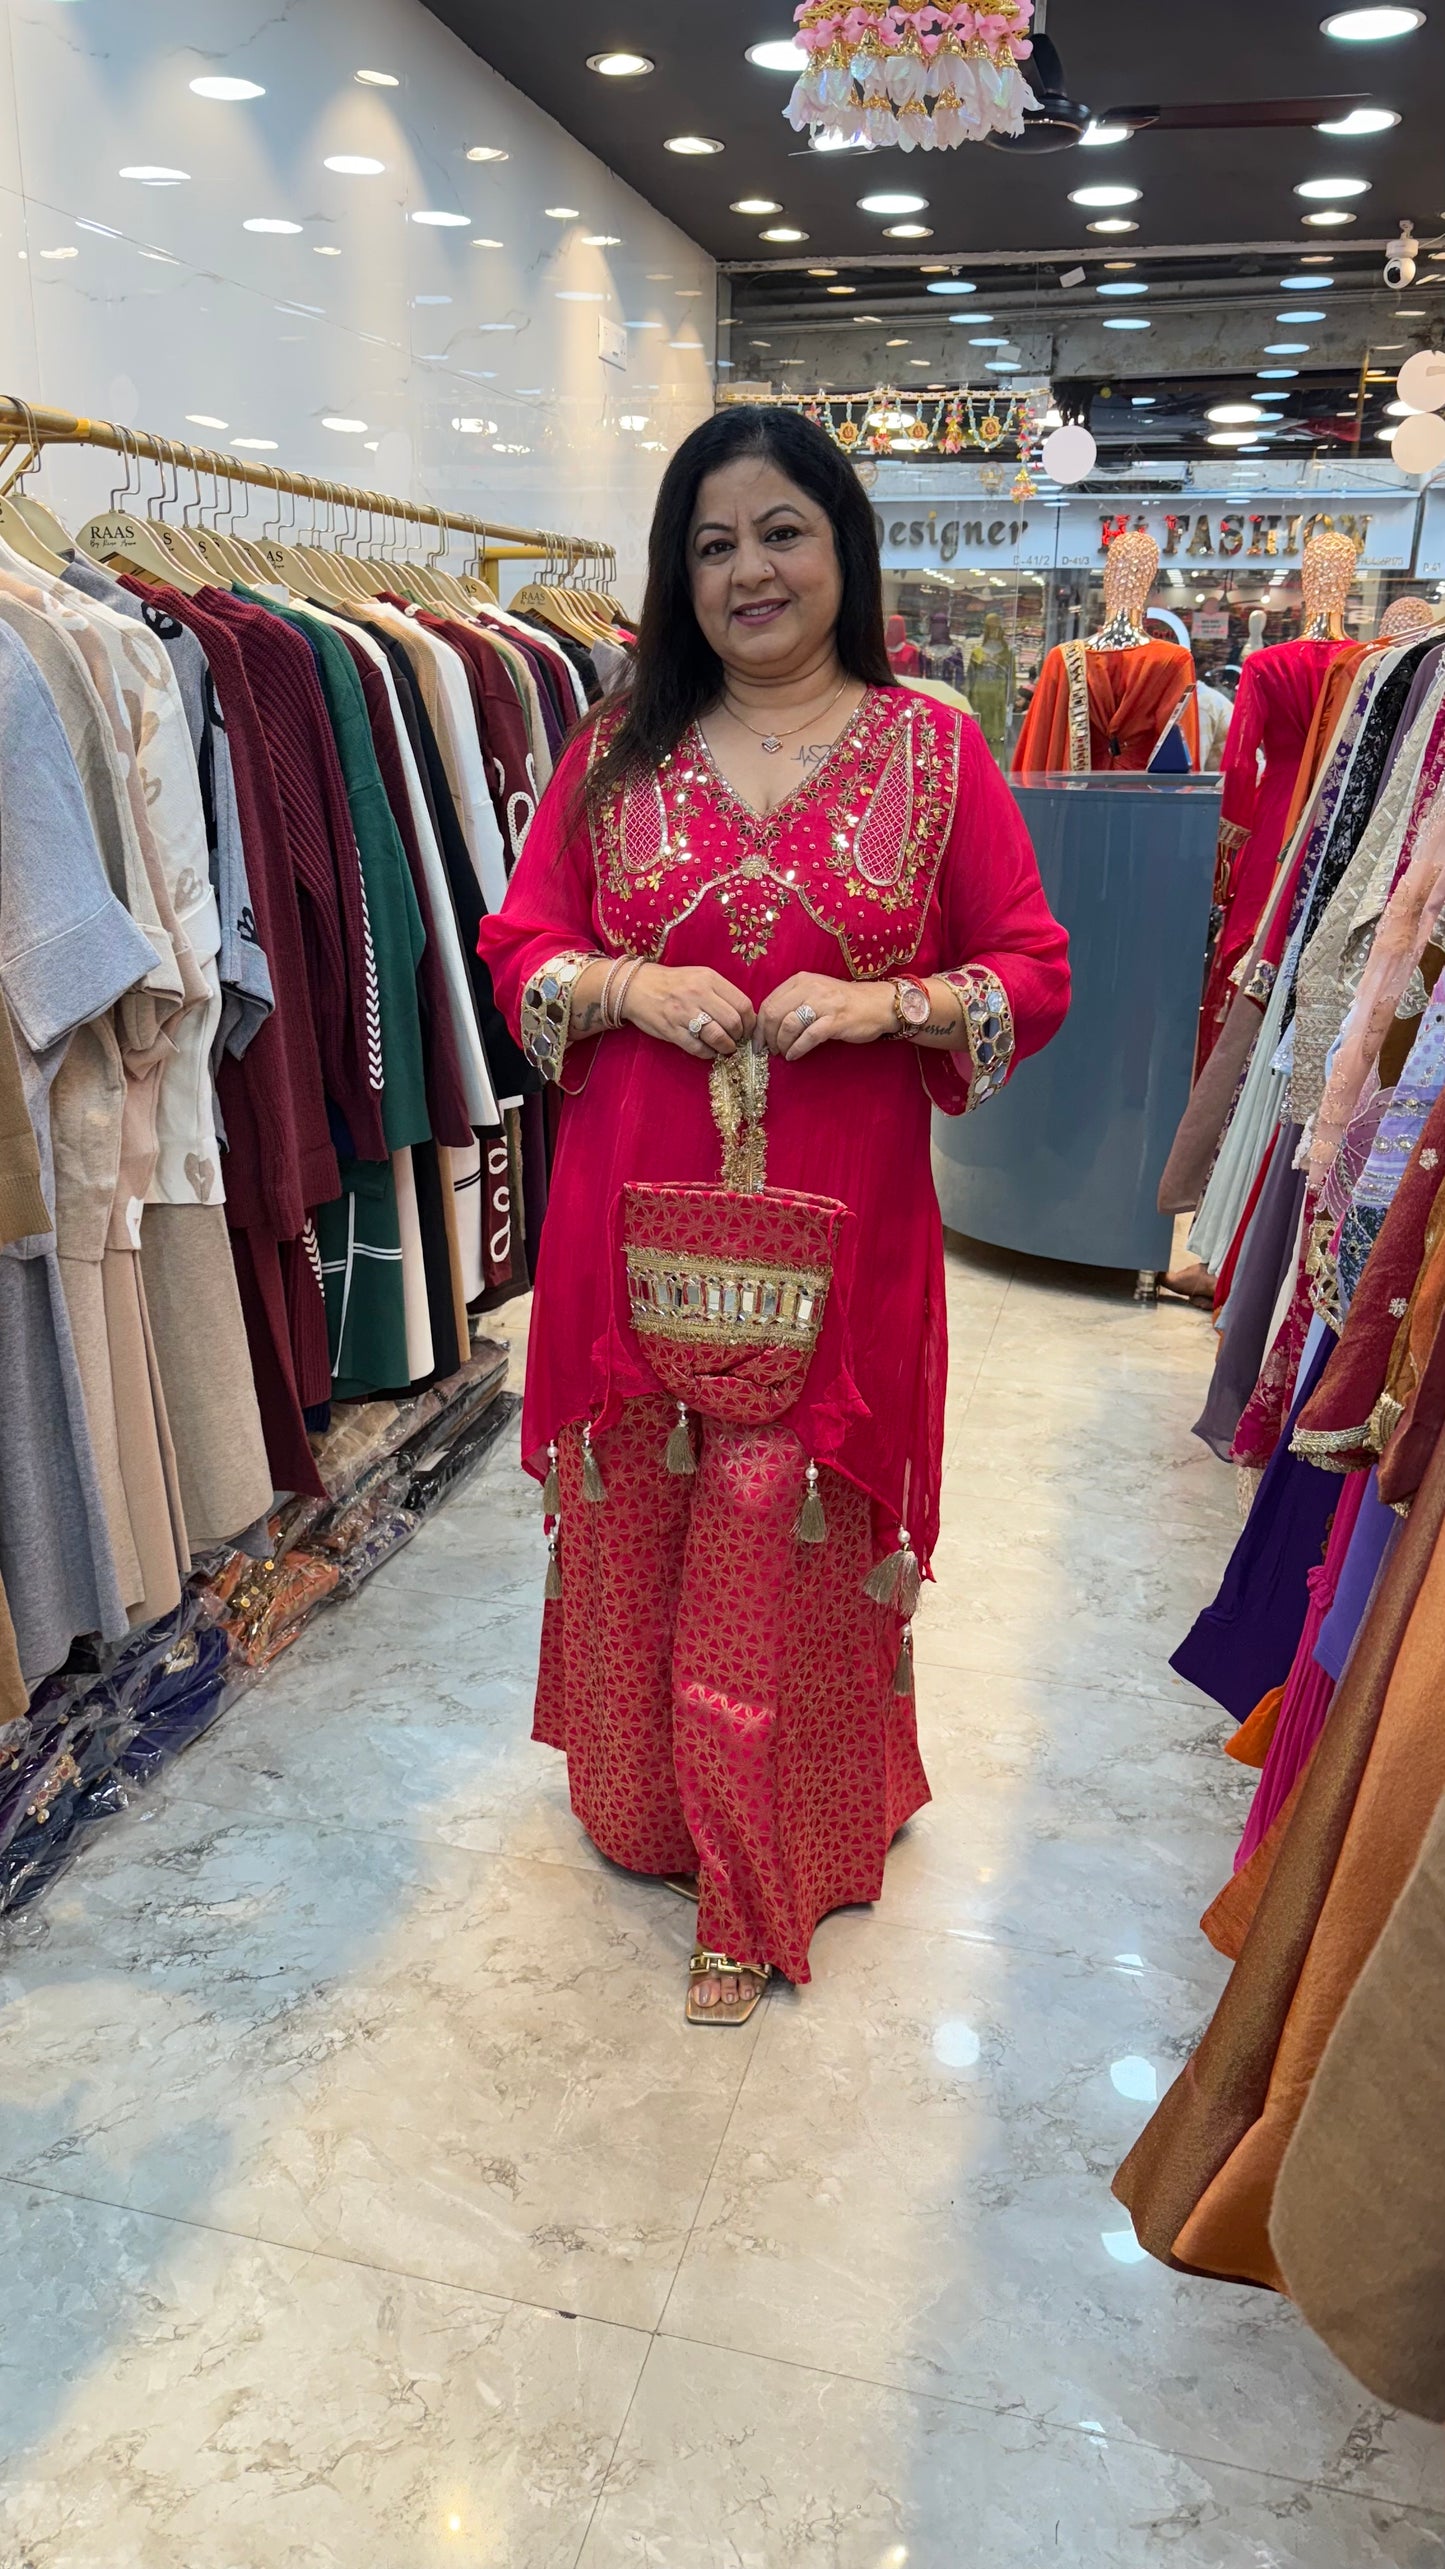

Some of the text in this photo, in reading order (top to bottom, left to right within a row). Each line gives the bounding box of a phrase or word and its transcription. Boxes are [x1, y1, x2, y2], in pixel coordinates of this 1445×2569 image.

[91, 526, 134, 539] RAAS
[1162, 512, 1373, 557] FASHION
[266, 550, 284, 562] AS
[521, 591, 545, 601] RAAS
[919, 1020, 956, 1036] essed
